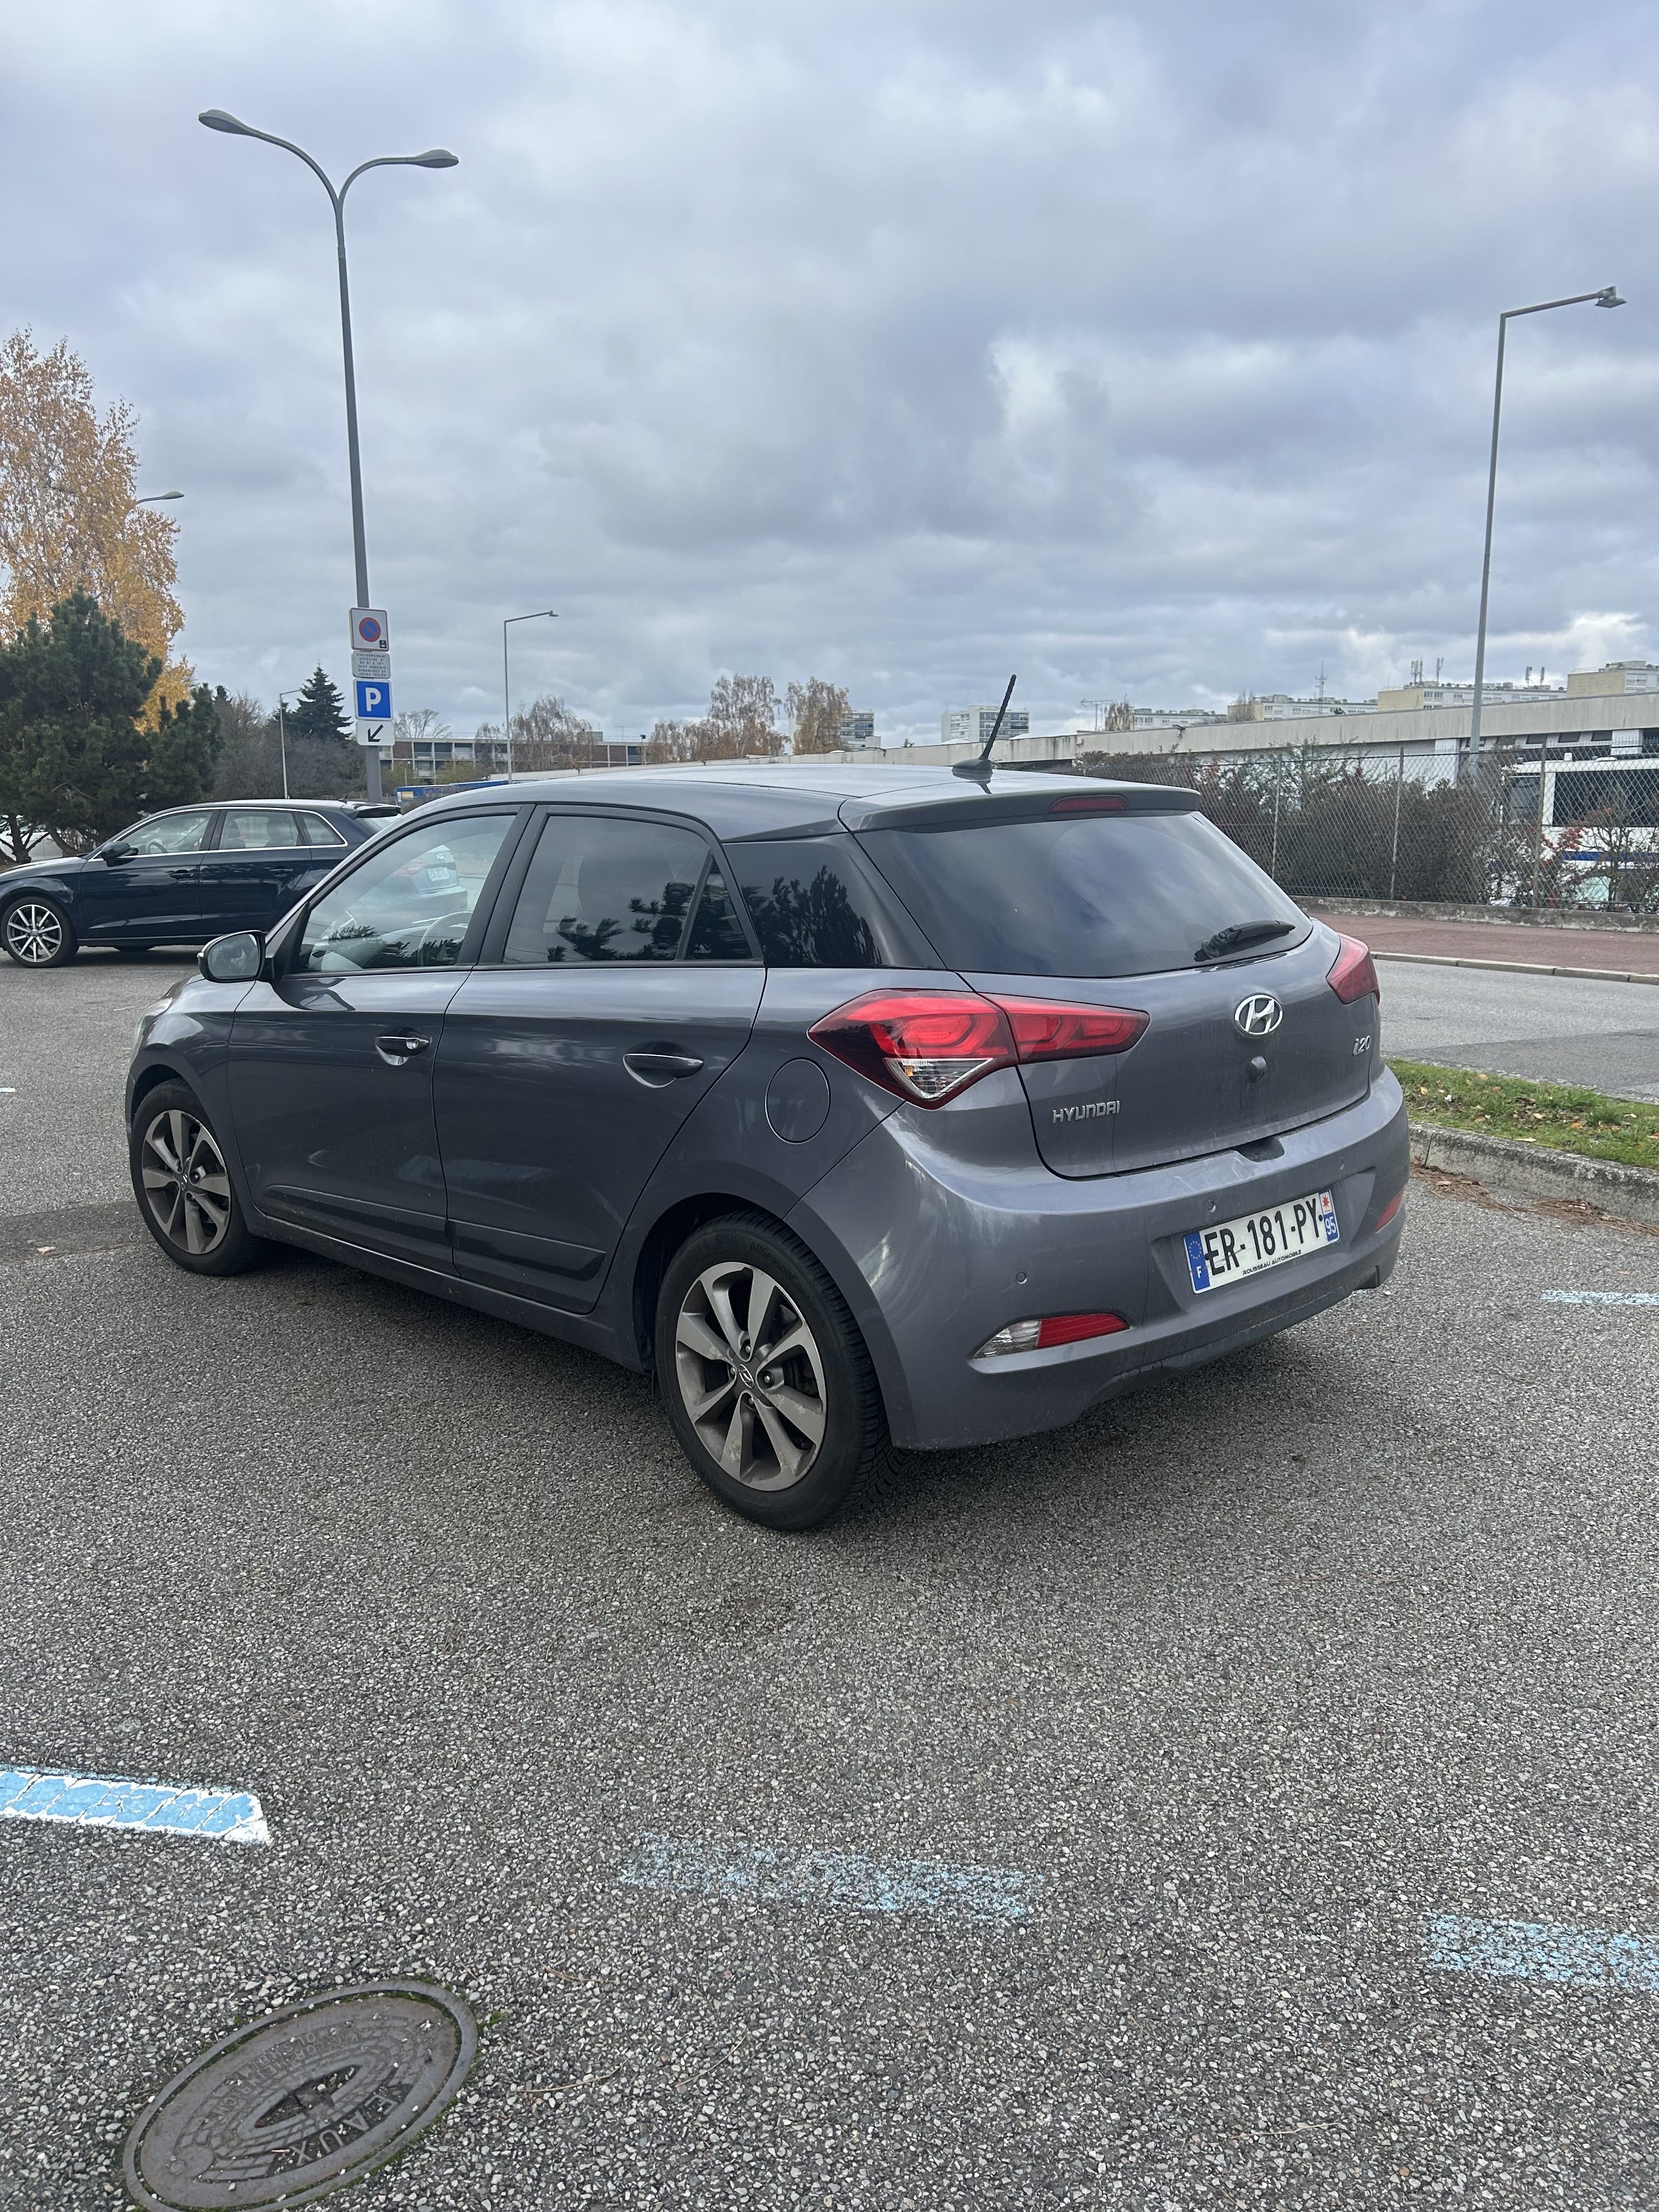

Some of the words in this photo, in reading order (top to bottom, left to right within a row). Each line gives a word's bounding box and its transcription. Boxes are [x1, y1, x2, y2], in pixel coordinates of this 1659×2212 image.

[365, 687, 381, 712] P
[1352, 1035, 1372, 1056] i20
[1052, 1100, 1120, 1124] HYUNDAI
[1204, 1198, 1320, 1276] ER-181-PY
[1324, 1216, 1336, 1235] 95
[1197, 1266, 1201, 1278] F
[1242, 1261, 1271, 1276] ROUSSEAU
[1272, 1249, 1302, 1265] AUTOMOBILE
[290, 2095, 398, 2166] EAUX
